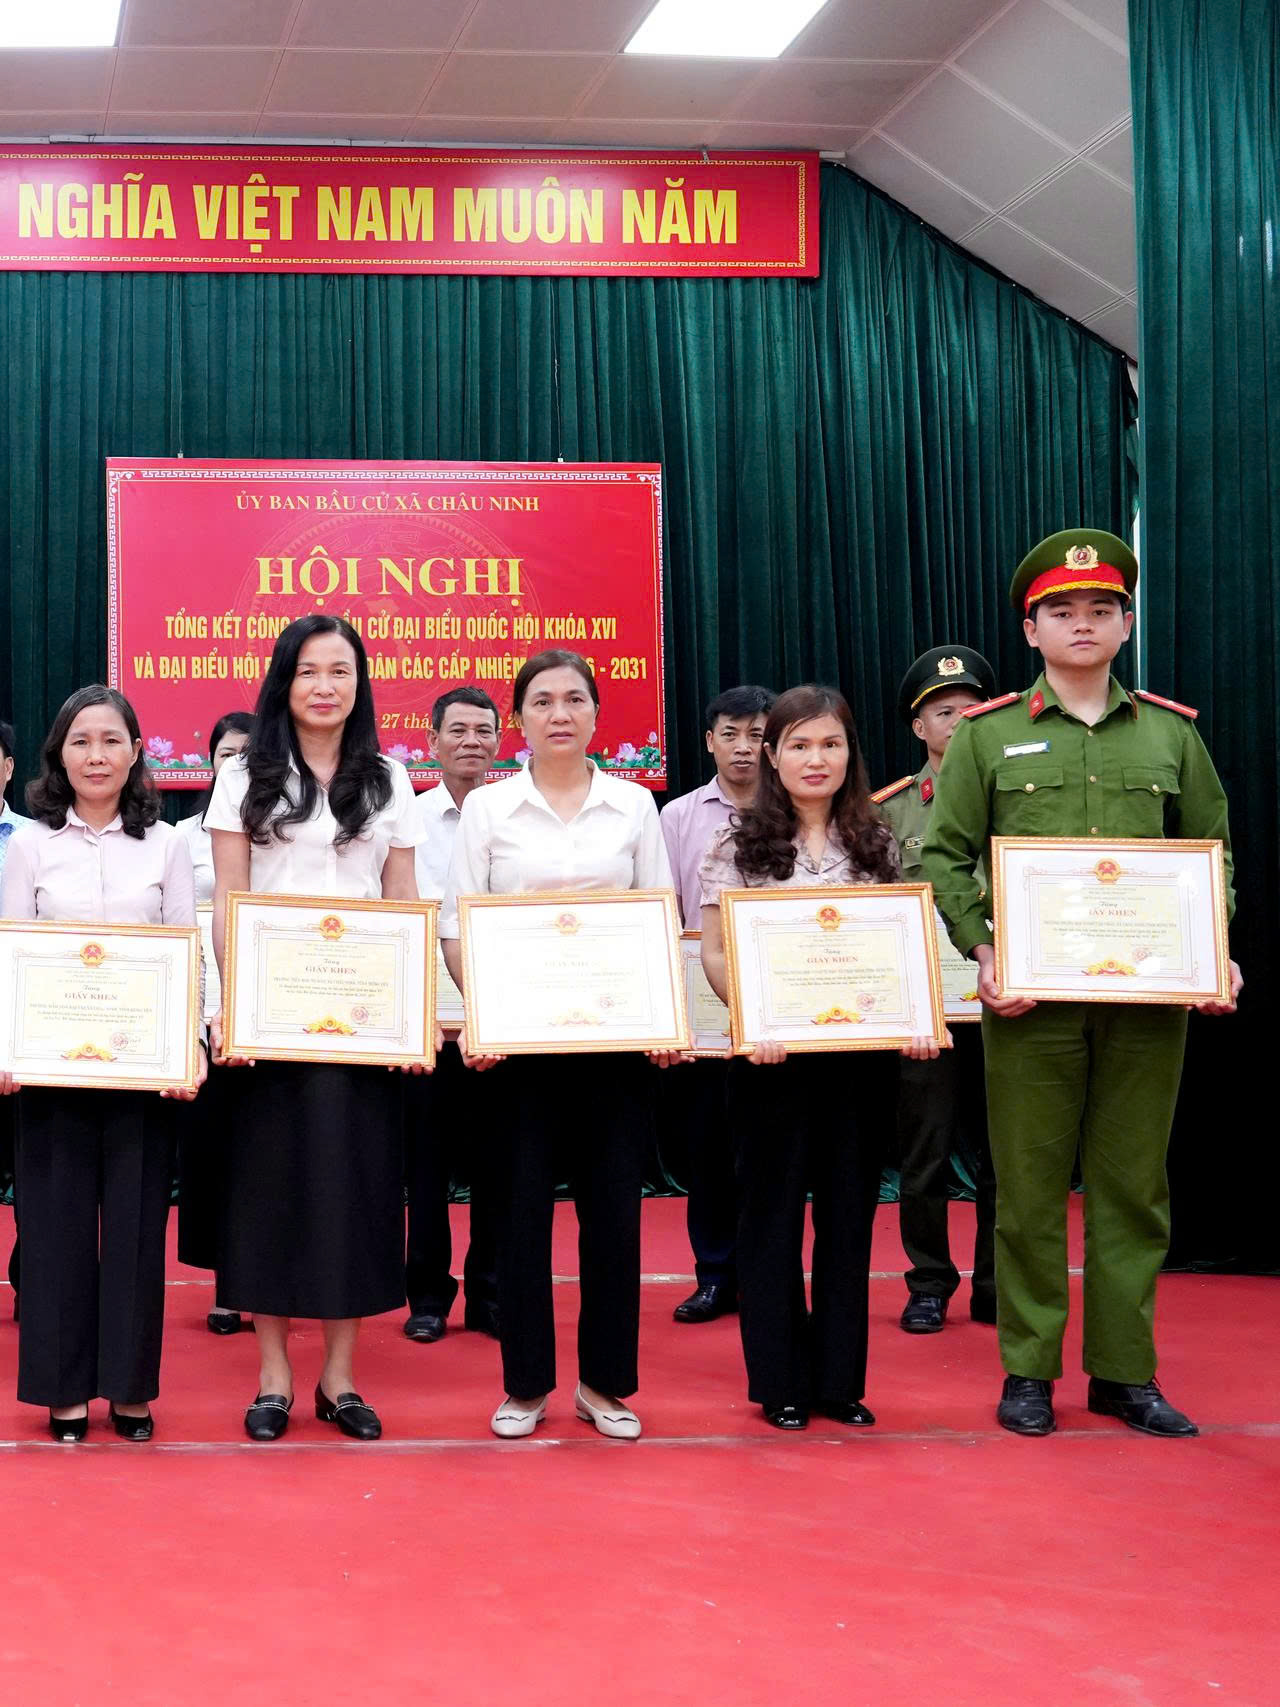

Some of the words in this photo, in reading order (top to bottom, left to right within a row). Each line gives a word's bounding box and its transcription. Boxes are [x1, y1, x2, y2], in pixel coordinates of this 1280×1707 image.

[18, 173, 177, 240] NGHĨA
[192, 175, 300, 253] VIỆT
[317, 187, 434, 242] NAM
[453, 176, 605, 244] MUÔN
[622, 177, 738, 244] NĂM
[236, 490, 264, 510] ỦY
[270, 495, 310, 510] BAN
[316, 489, 357, 511] BẦU
[362, 492, 390, 511] CỬ
[395, 492, 422, 511] XÃ
[428, 492, 484, 512] CHÂU
[490, 496, 539, 512] NINH
[256, 545, 363, 606] HỘI
[377, 557, 525, 607] NGHỊ
[165, 607, 208, 639] TỔNG
[213, 608, 242, 639] KẾT
[367, 609, 391, 640] CỬ
[393, 616, 420, 644] ĐẠI
[425, 608, 462, 640] BIỂU
[466, 609, 509, 642] QUỐC
[513, 613, 540, 644] HỘI
[545, 611, 587, 640] KHÓA
[591, 617, 617, 640] XVI
[133, 652, 155, 679] VÀ
[159, 656, 187, 684] ĐẠI
[192, 647, 228, 679] BIỂU
[233, 651, 260, 684] HỘI
[402, 652, 434, 680] CÁC
[439, 649, 471, 680] CẤP
[610, 657, 648, 680] 2031
[381, 713, 401, 729] 27
[404, 713, 433, 729] thá
